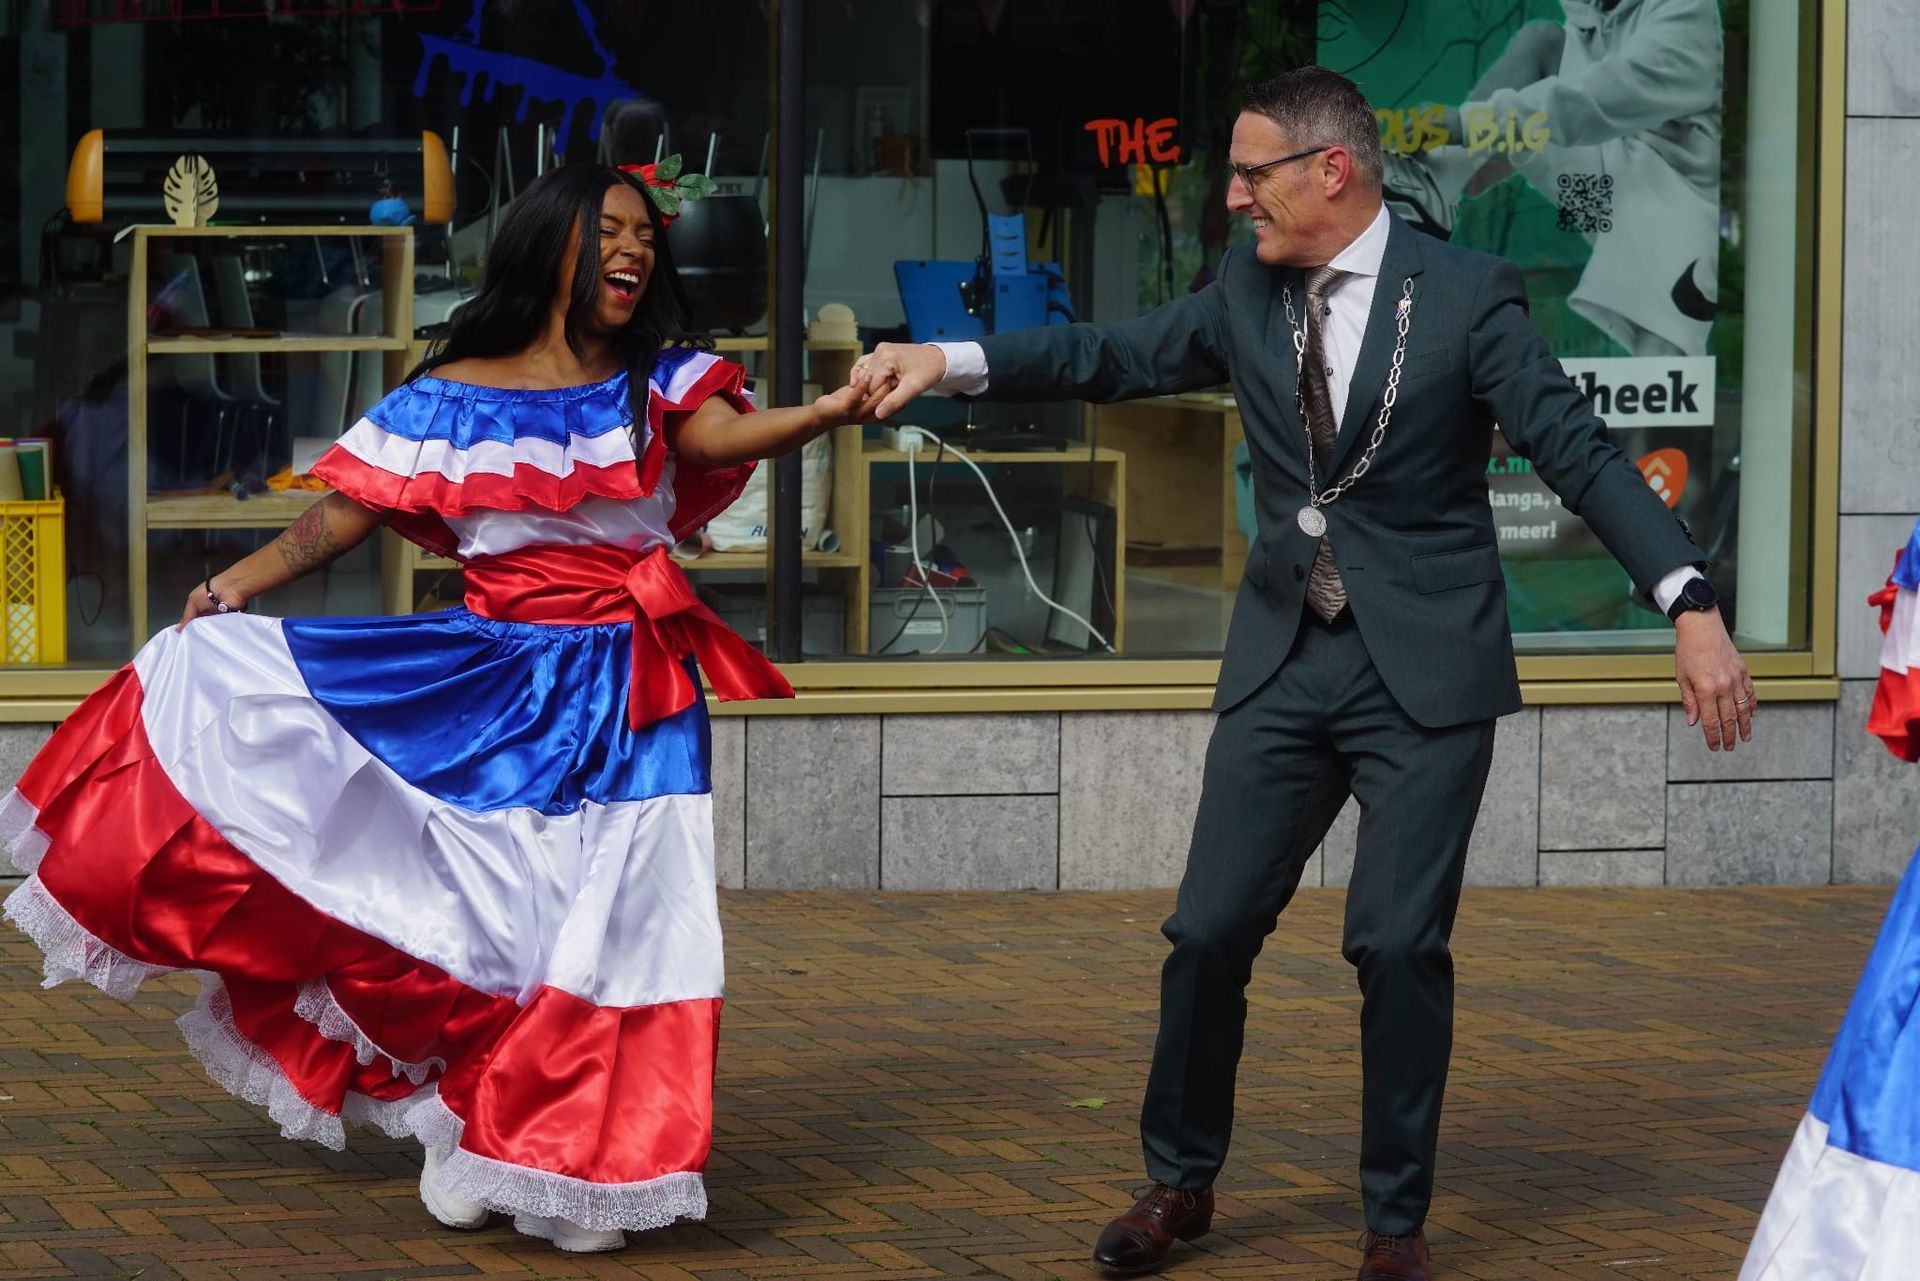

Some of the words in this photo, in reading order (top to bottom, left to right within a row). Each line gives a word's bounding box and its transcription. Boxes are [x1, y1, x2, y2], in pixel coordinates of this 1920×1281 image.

[1084, 118, 1181, 169] THE
[1570, 370, 1699, 415] heek
[1499, 520, 1557, 539] meer!
